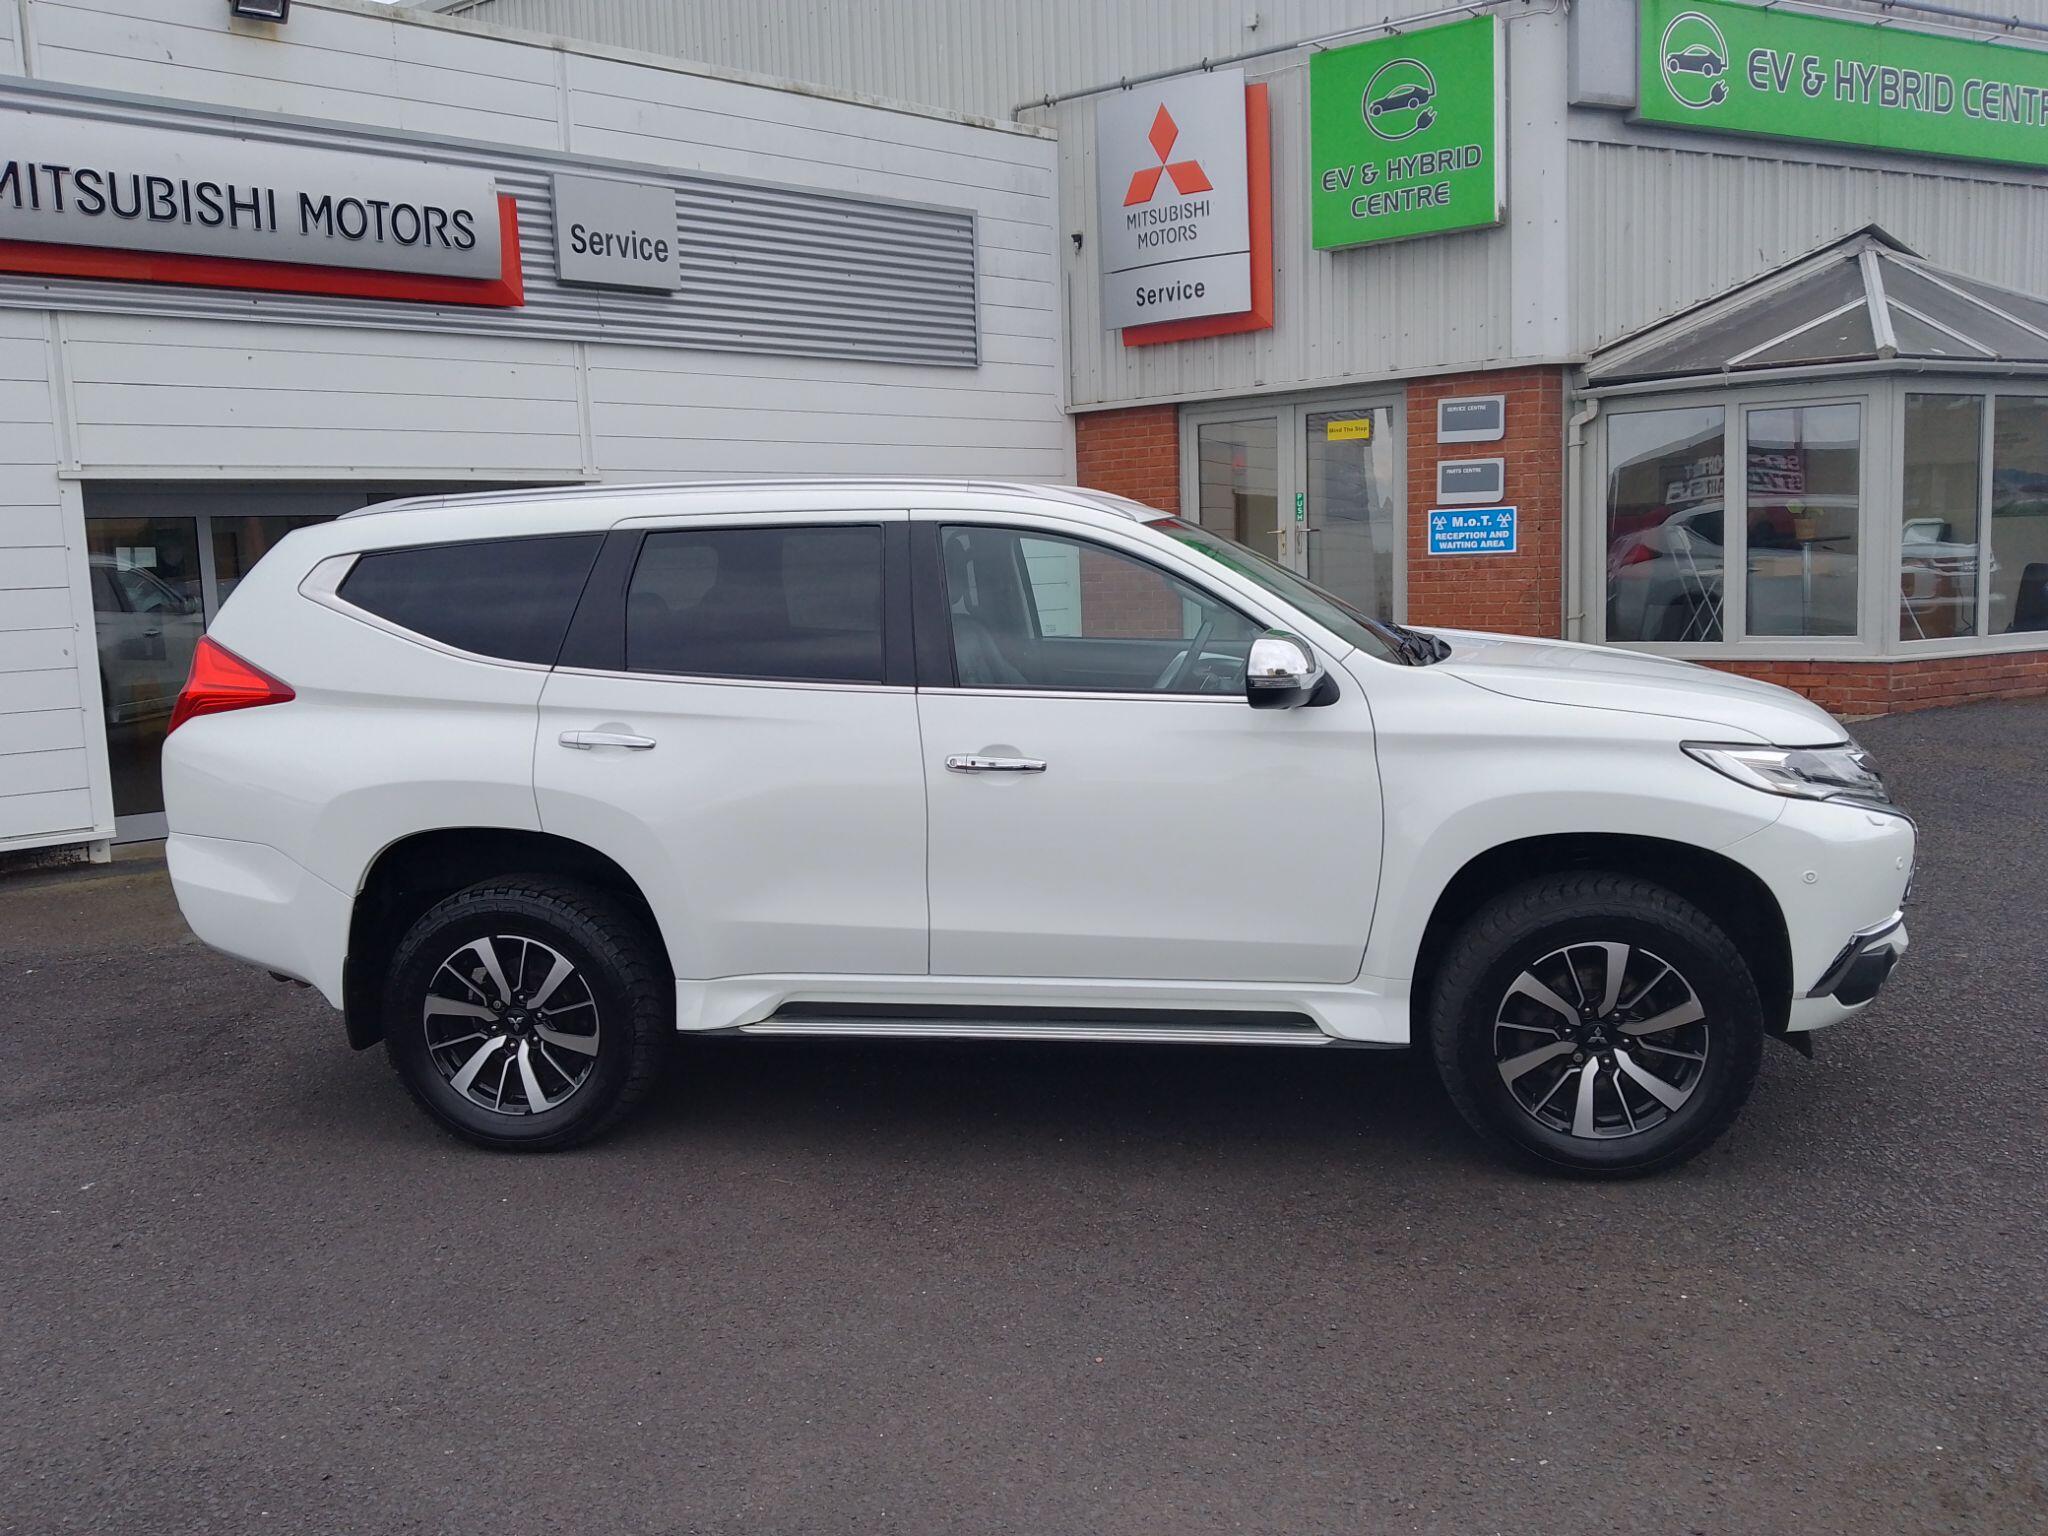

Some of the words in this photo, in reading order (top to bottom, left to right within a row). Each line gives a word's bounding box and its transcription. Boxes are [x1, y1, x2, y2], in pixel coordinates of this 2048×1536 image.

[1747, 48, 1795, 93] EV
[1801, 56, 1827, 97] &
[1834, 59, 1956, 114] HYBRID
[1321, 167, 1355, 192] EV
[1361, 163, 1379, 186] &
[1387, 144, 1482, 182] HYBRID
[1126, 200, 1210, 231] MITSUBISHI
[1350, 181, 1450, 219] CENTRE
[299, 193, 477, 251] MOTORS
[1138, 224, 1197, 249] MOTORS
[570, 223, 669, 263] Service
[1136, 280, 1205, 307] Service
[1435, 532, 1487, 541] RECEPTION
[1489, 530, 1509, 539] AND
[1439, 541, 1478, 549] WAITING
[1480, 539, 1506, 548] AREA
